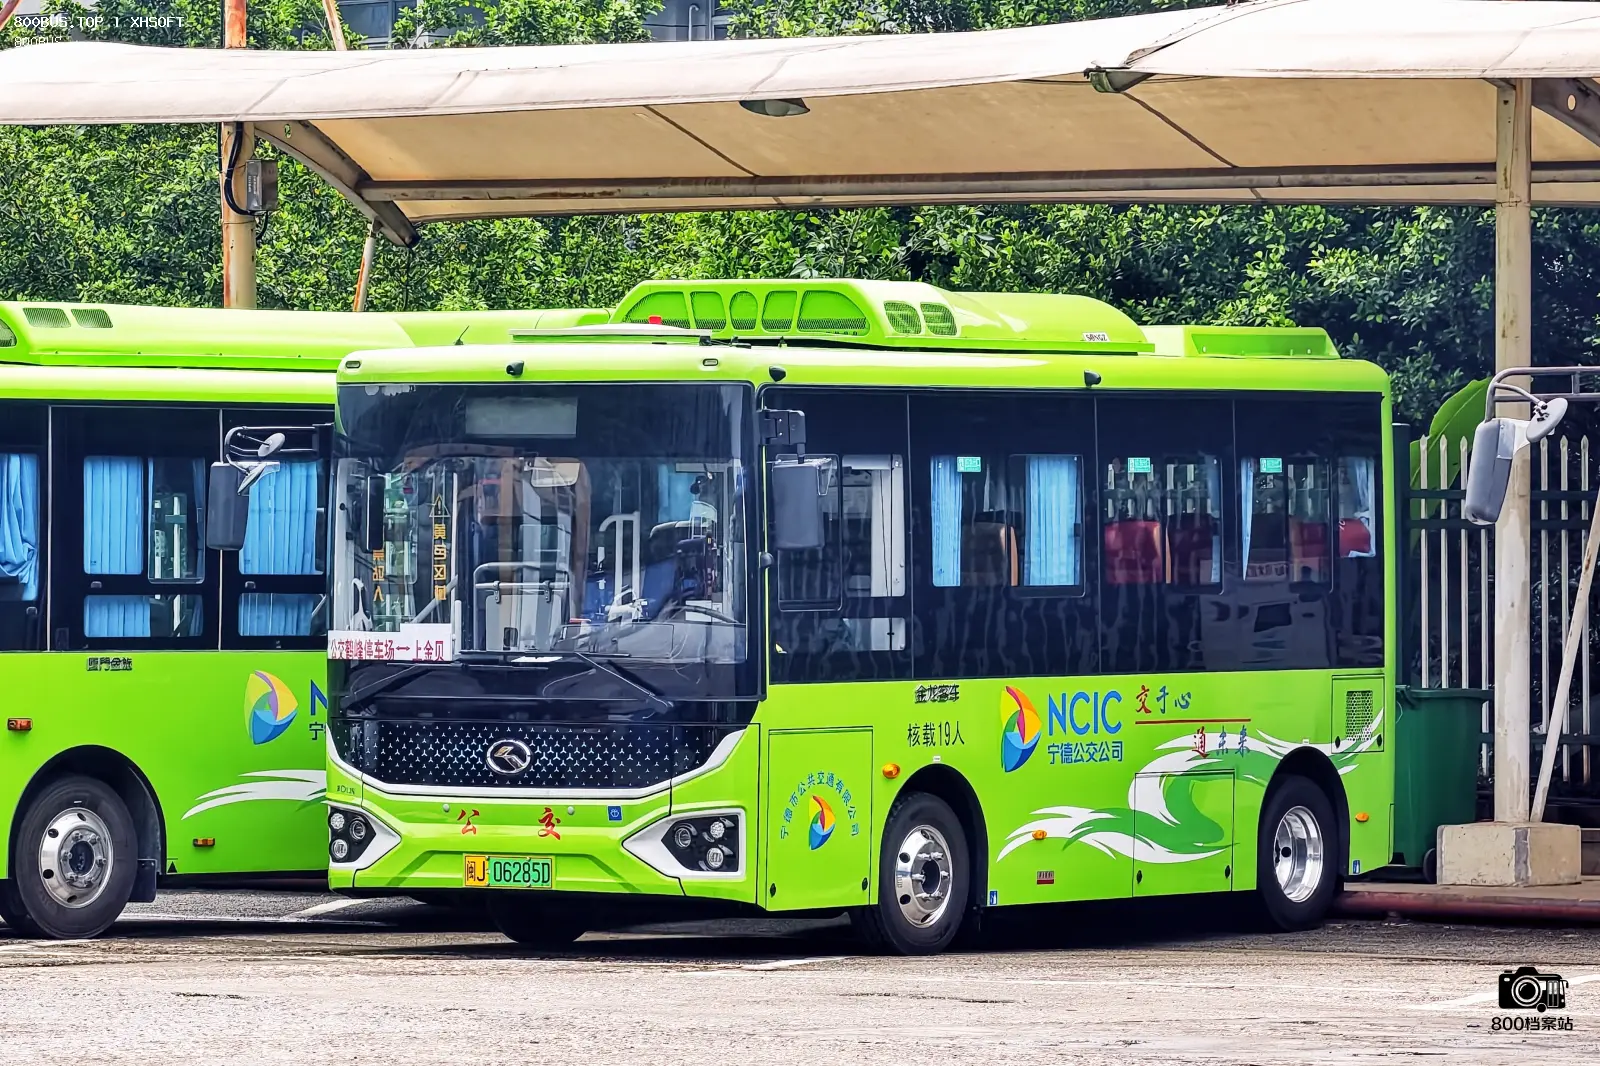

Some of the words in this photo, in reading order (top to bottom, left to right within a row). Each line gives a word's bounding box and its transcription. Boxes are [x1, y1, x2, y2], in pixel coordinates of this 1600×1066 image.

[1048, 690, 1123, 736] NCIC
[907, 720, 965, 748] 核载19人
[1047, 741, 1123, 765] 宁德公交公司
